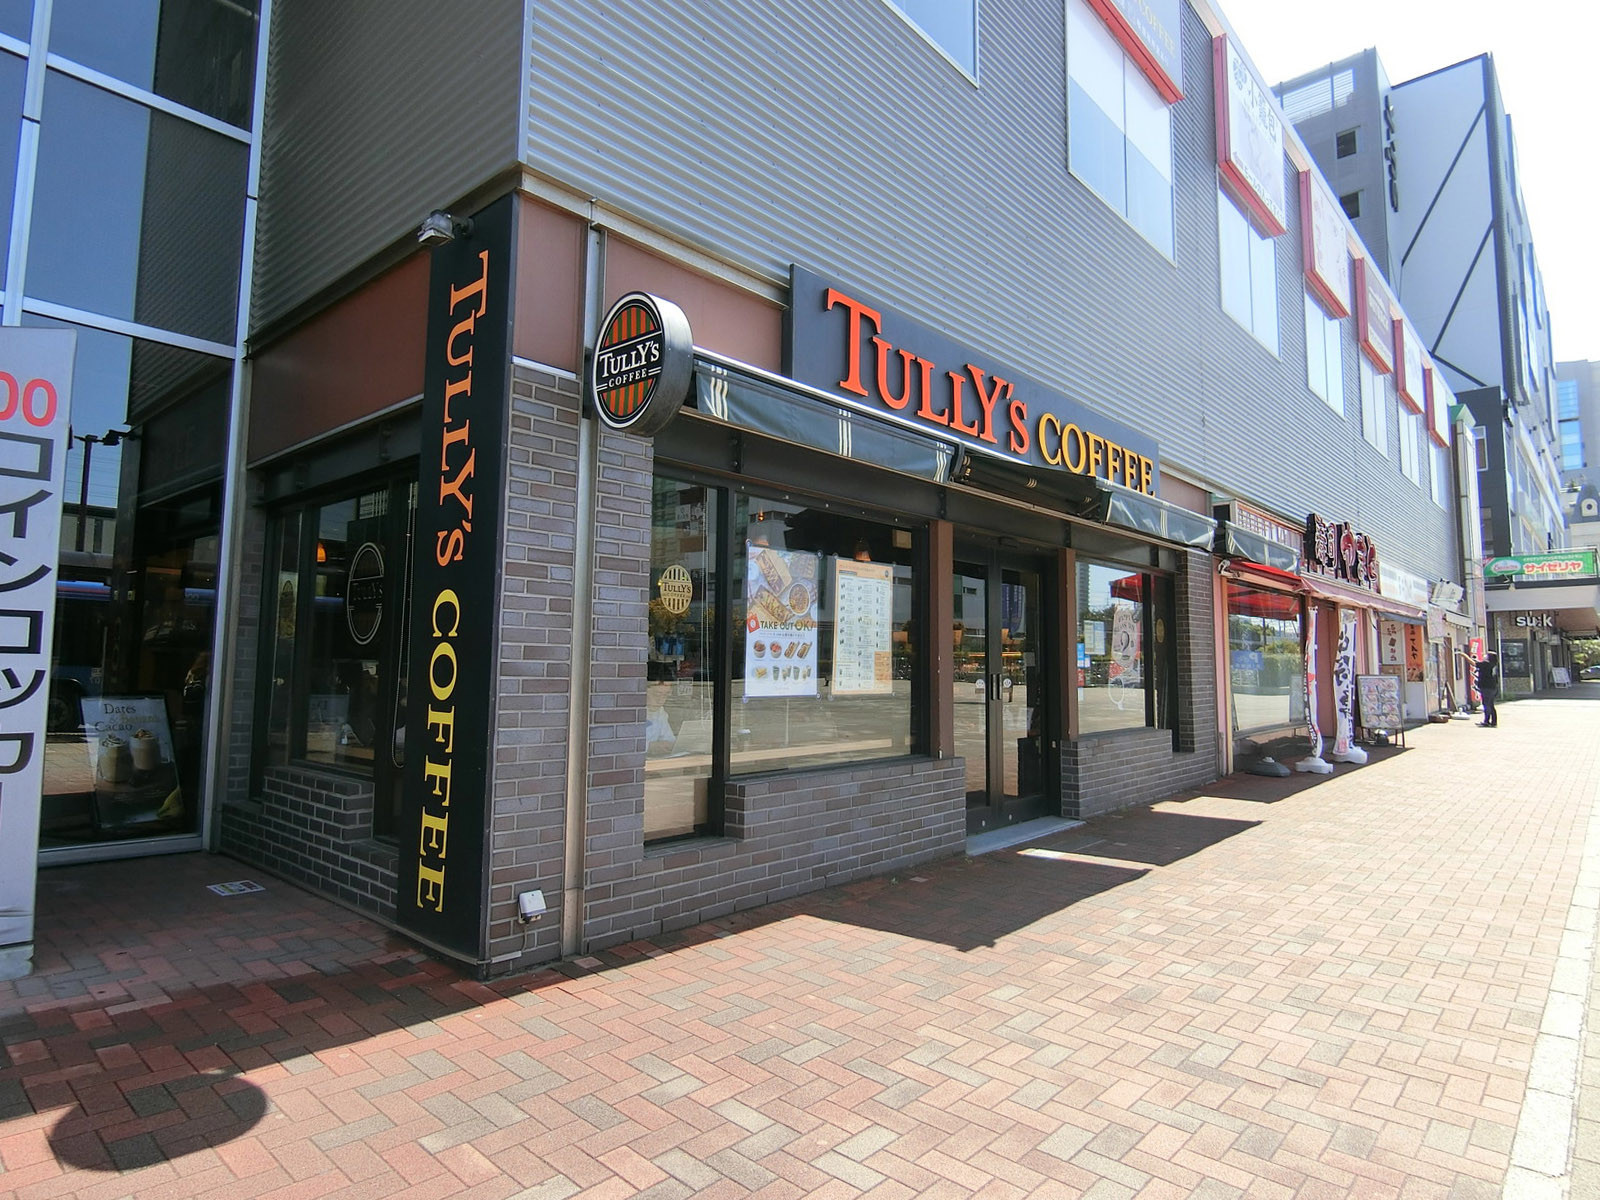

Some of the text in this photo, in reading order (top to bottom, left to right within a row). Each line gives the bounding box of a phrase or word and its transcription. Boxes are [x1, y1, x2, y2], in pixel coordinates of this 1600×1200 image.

[599, 340, 660, 378] TULLY'S
[608, 368, 647, 388] COFFEE
[826, 287, 1156, 498] TULLY'S COFFEE
[1523, 561, 1582, 573] サイゼリヤ
[415, 249, 489, 912] TULLY'S COFFEE
[760, 620, 778, 630] TAKE
[779, 621, 794, 630] OUT
[104, 703, 136, 714] Dates
[95, 721, 133, 732] Cacao
